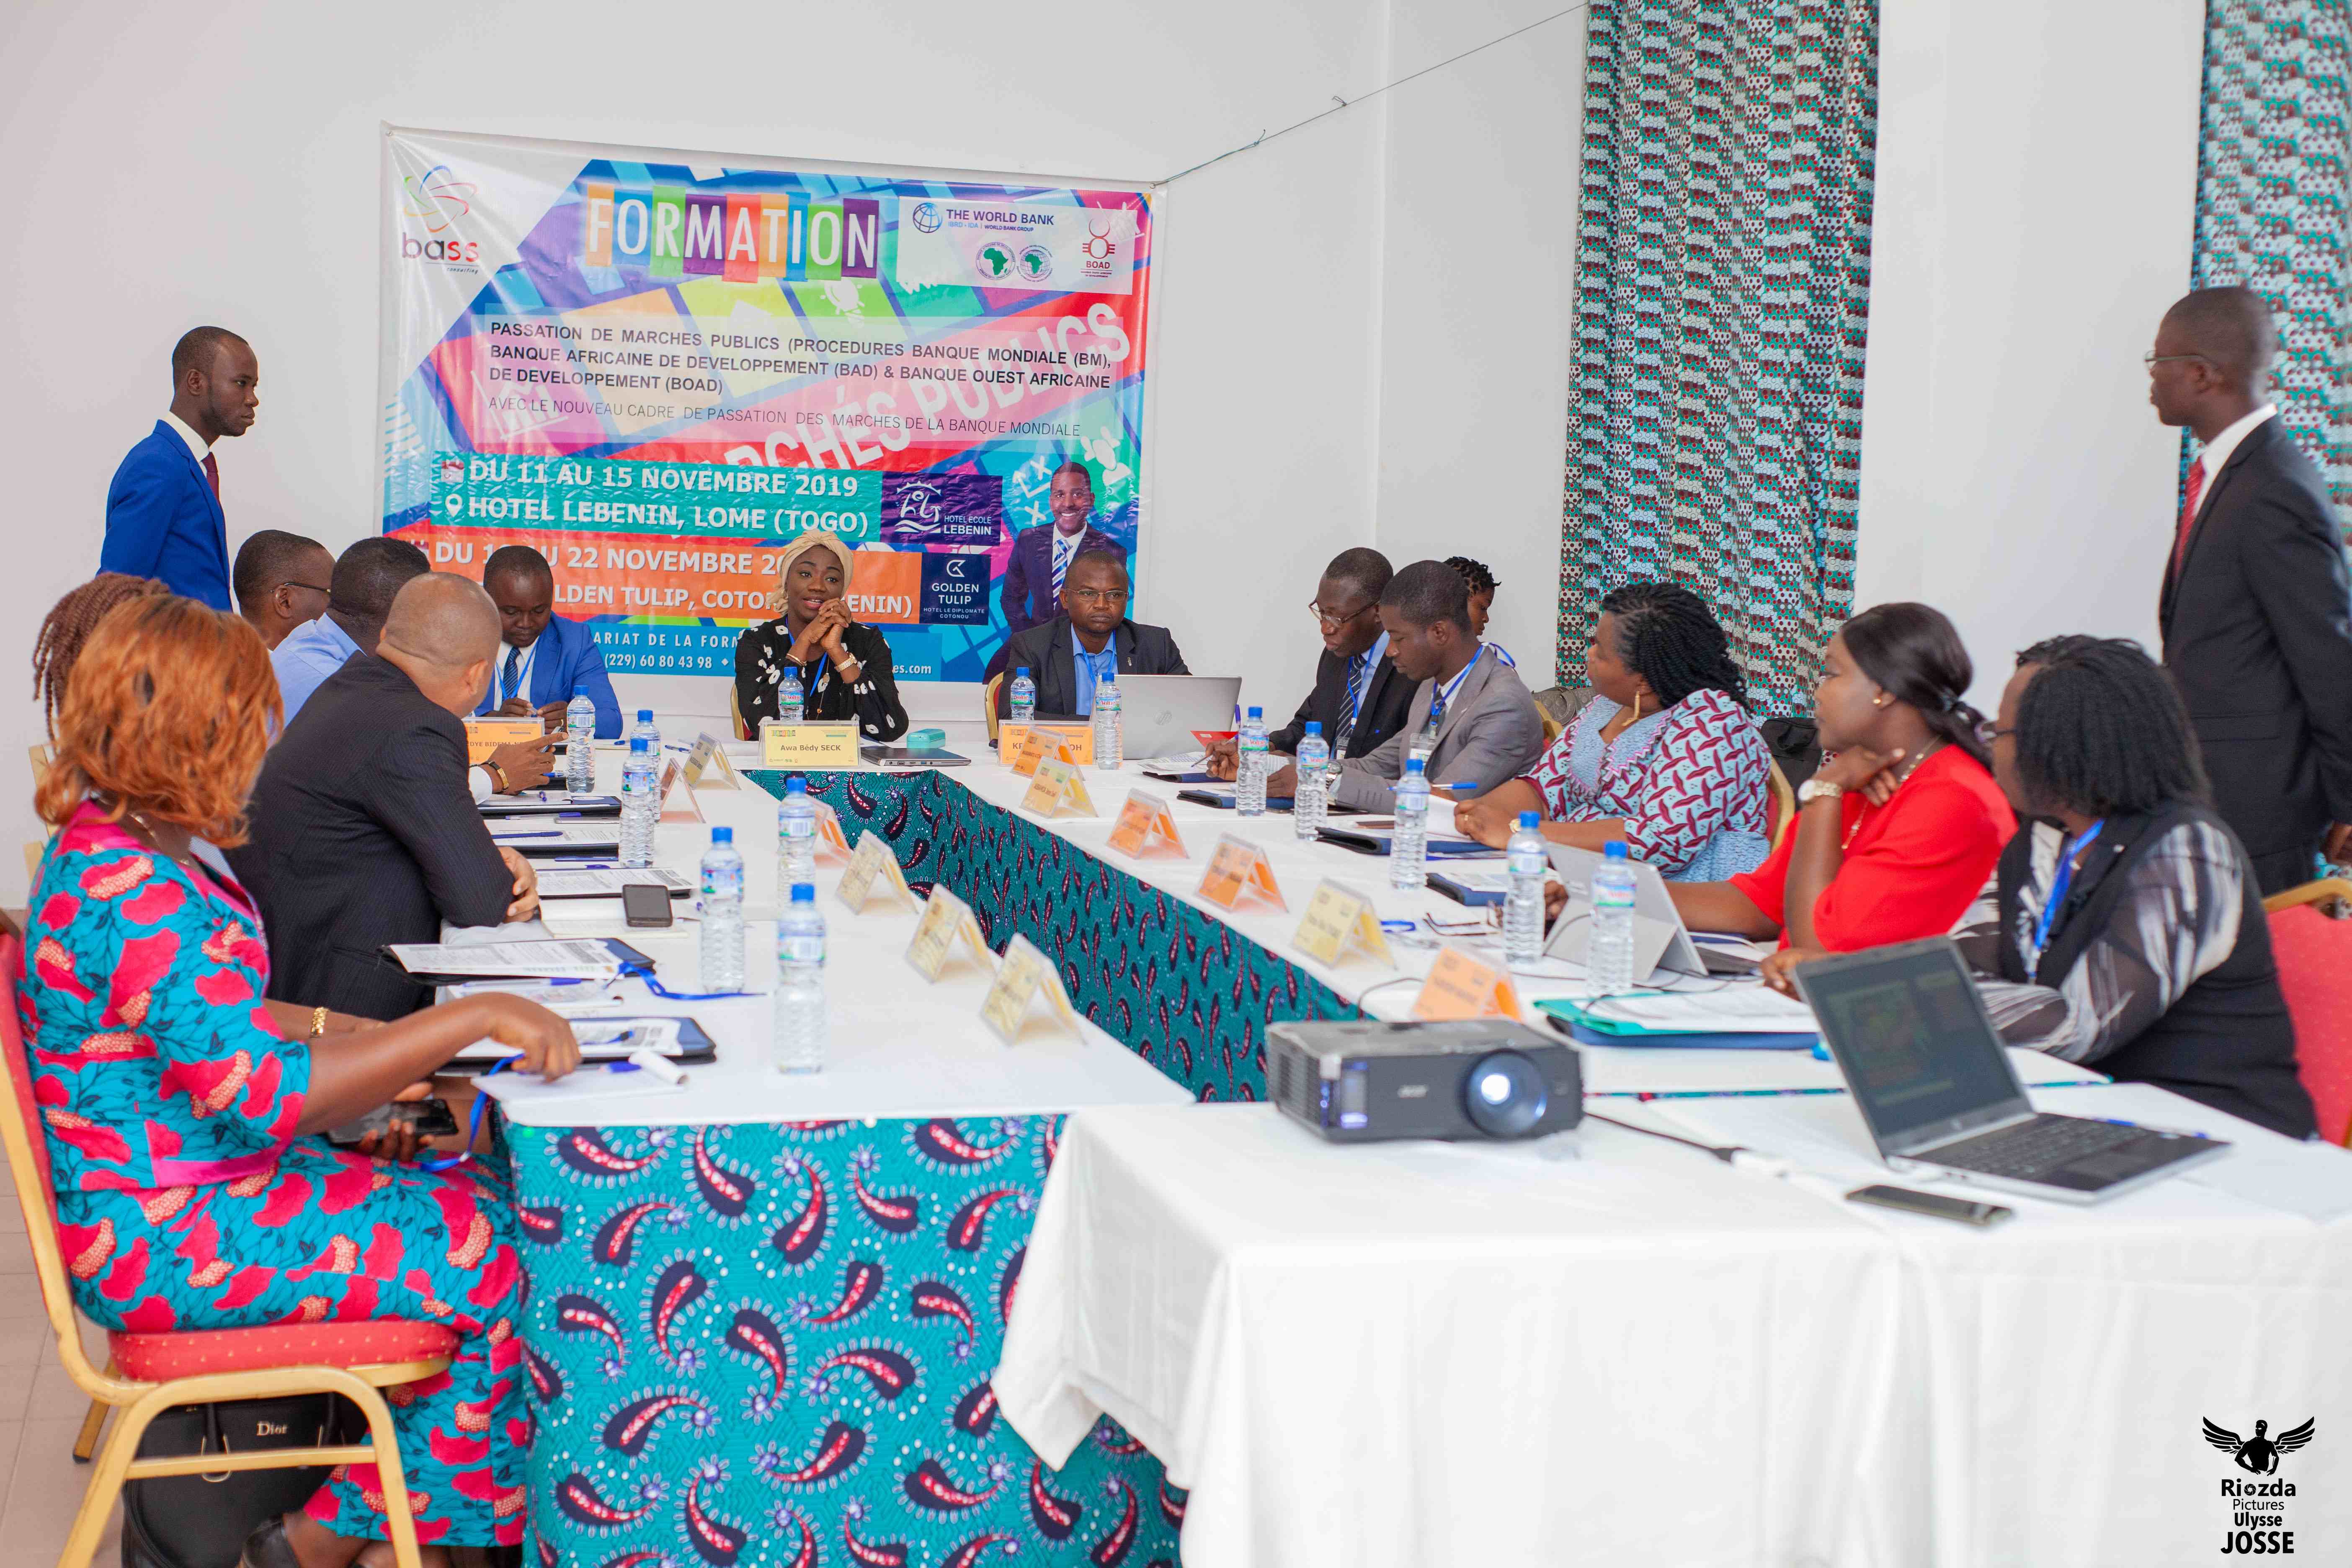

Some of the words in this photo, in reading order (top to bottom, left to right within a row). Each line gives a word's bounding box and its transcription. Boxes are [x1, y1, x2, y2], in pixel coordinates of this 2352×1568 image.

[946, 209, 970, 220] THE
[973, 211, 1017, 223] WORLD
[1021, 214, 1054, 225] BANK
[402, 232, 479, 262] bass
[588, 198, 876, 268] FORMATION
[491, 322, 583, 341] PASSATION
[592, 328, 613, 341] DE
[622, 329, 702, 346] MARCHES
[711, 334, 779, 351] PUBLICS
[788, 337, 904, 357] (PROCEDURES
[913, 344, 980, 361] BANQUE
[988, 348, 1067, 365] MONDIALE
[1074, 351, 1112, 369] (BM),
[490, 367, 512, 382] DE
[518, 369, 660, 391] DEVELOPPEMENT
[665, 376, 723, 396] (BOAD)
[491, 345, 561, 363] BANQUE
[567, 349, 653, 367] AFRICAINE
[660, 354, 681, 368] DE
[687, 355, 829, 376] DEVELOPPEMENT
[834, 363, 879, 380] (BAD)
[884, 367, 895, 379] &
[900, 366, 967, 383] BANQUE
[973, 369, 1024, 385] OUEST
[1030, 372, 1110, 389] AFRICAINE
[909, 302, 1130, 435] PUBLICS
[489, 397, 527, 410] AVEC
[531, 400, 549, 412] LE
[553, 400, 623, 416] NOUVEAU
[628, 404, 675, 419] CADRE
[684, 407, 703, 420] DE
[707, 408, 787, 424] PASSATION
[796, 413, 824, 425] DES
[833, 414, 901, 429] MARCHES
[905, 418, 924, 430] DE
[927, 419, 945, 431] LA
[949, 420, 1006, 435] BANQUE
[1010, 422, 1080, 437] MONDIALE
[469, 459, 507, 482] DU
[518, 462, 548, 484] 11
[556, 464, 592, 486] AU
[603, 466, 632, 488] 15
[641, 468, 787, 495] NOVEMBRE
[796, 475, 858, 497] 2019
[469, 496, 554, 521] HOTEL
[563, 500, 684, 530] LEBENIN,
[694, 506, 766, 529] LOME
[774, 509, 869, 538] (TOGO)
[944, 525, 992, 536] LEBENIN
[436, 542, 474, 564] DU
[567, 547, 598, 568] 22
[607, 549, 752, 575] NOVEMBRE
[554, 584, 613, 605] LDEN
[621, 588, 694, 611] TULIP,
[842, 594, 912, 619] ENIN)
[931, 583, 979, 593] GOLDEN
[938, 595, 972, 605] TULIP
[649, 633, 666, 646] DE
[675, 634, 692, 647] LA
[604, 654, 636, 669] (229)
[640, 654, 654, 667] 60
[659, 655, 674, 668] 80
[678, 656, 693, 668] 43
[697, 656, 712, 669] 98
[800, 744, 819, 752] Bédy
[256, 1421, 287, 1436] Dior
